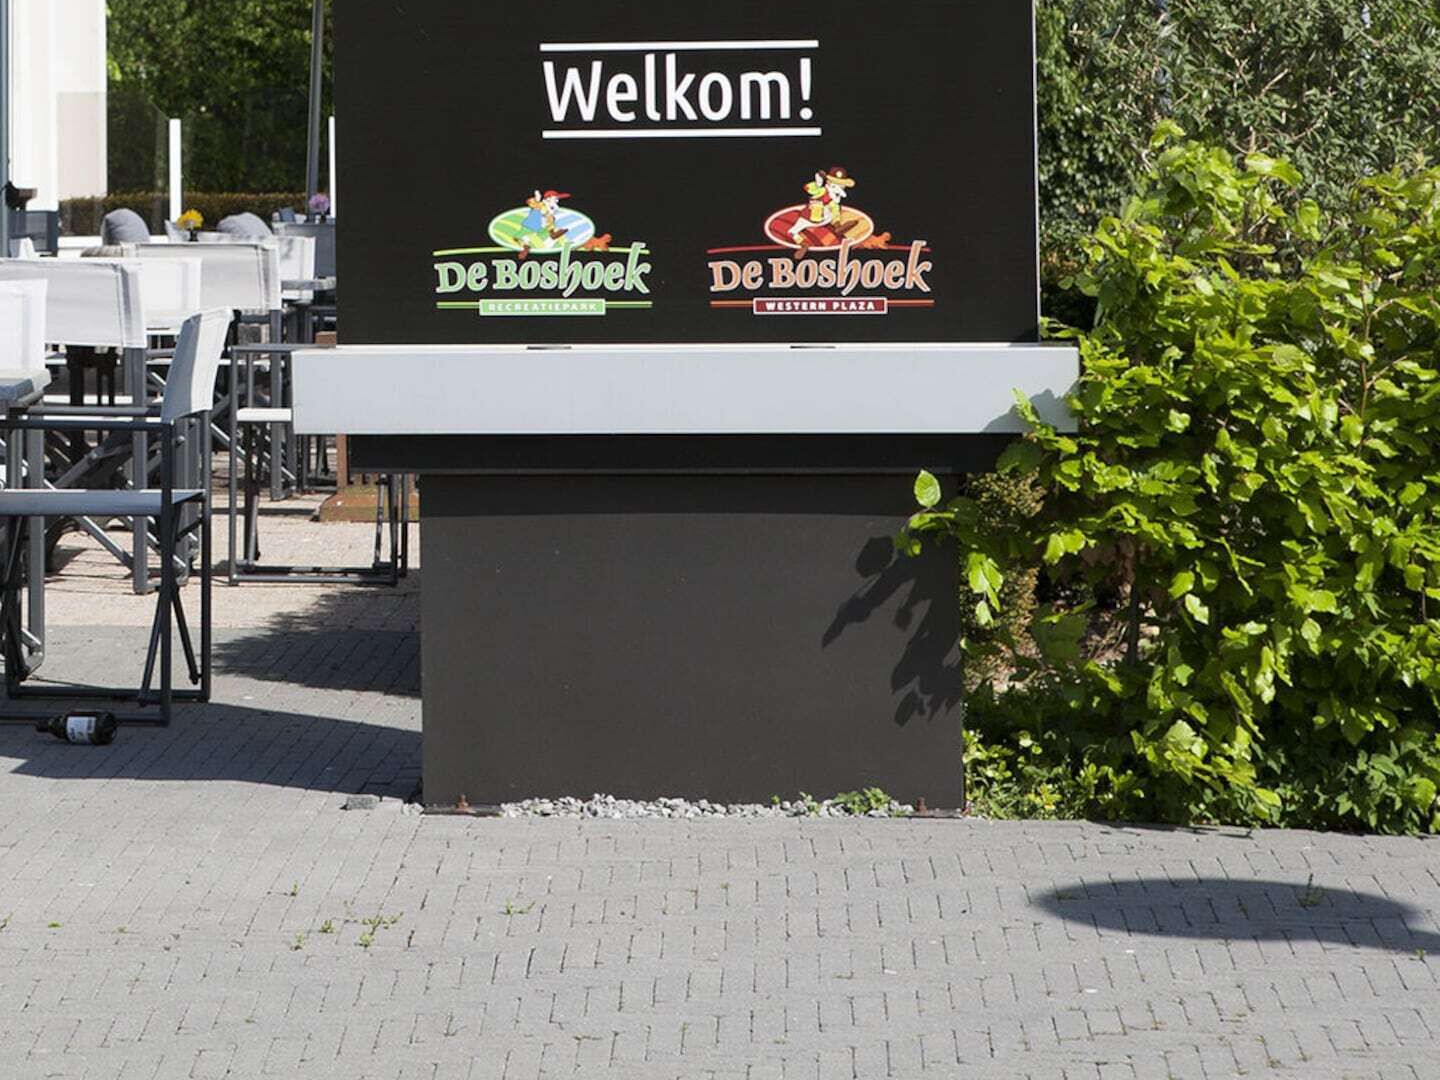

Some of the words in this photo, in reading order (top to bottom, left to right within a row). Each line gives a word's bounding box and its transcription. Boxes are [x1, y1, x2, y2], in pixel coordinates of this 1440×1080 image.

[543, 52, 813, 122] Welkom!
[492, 241, 652, 298] Boshoek
[768, 238, 932, 296] Boshoek
[488, 302, 598, 313] RECREATIEPARK
[765, 301, 827, 311] WESTERN
[832, 300, 876, 311] PLAZA
